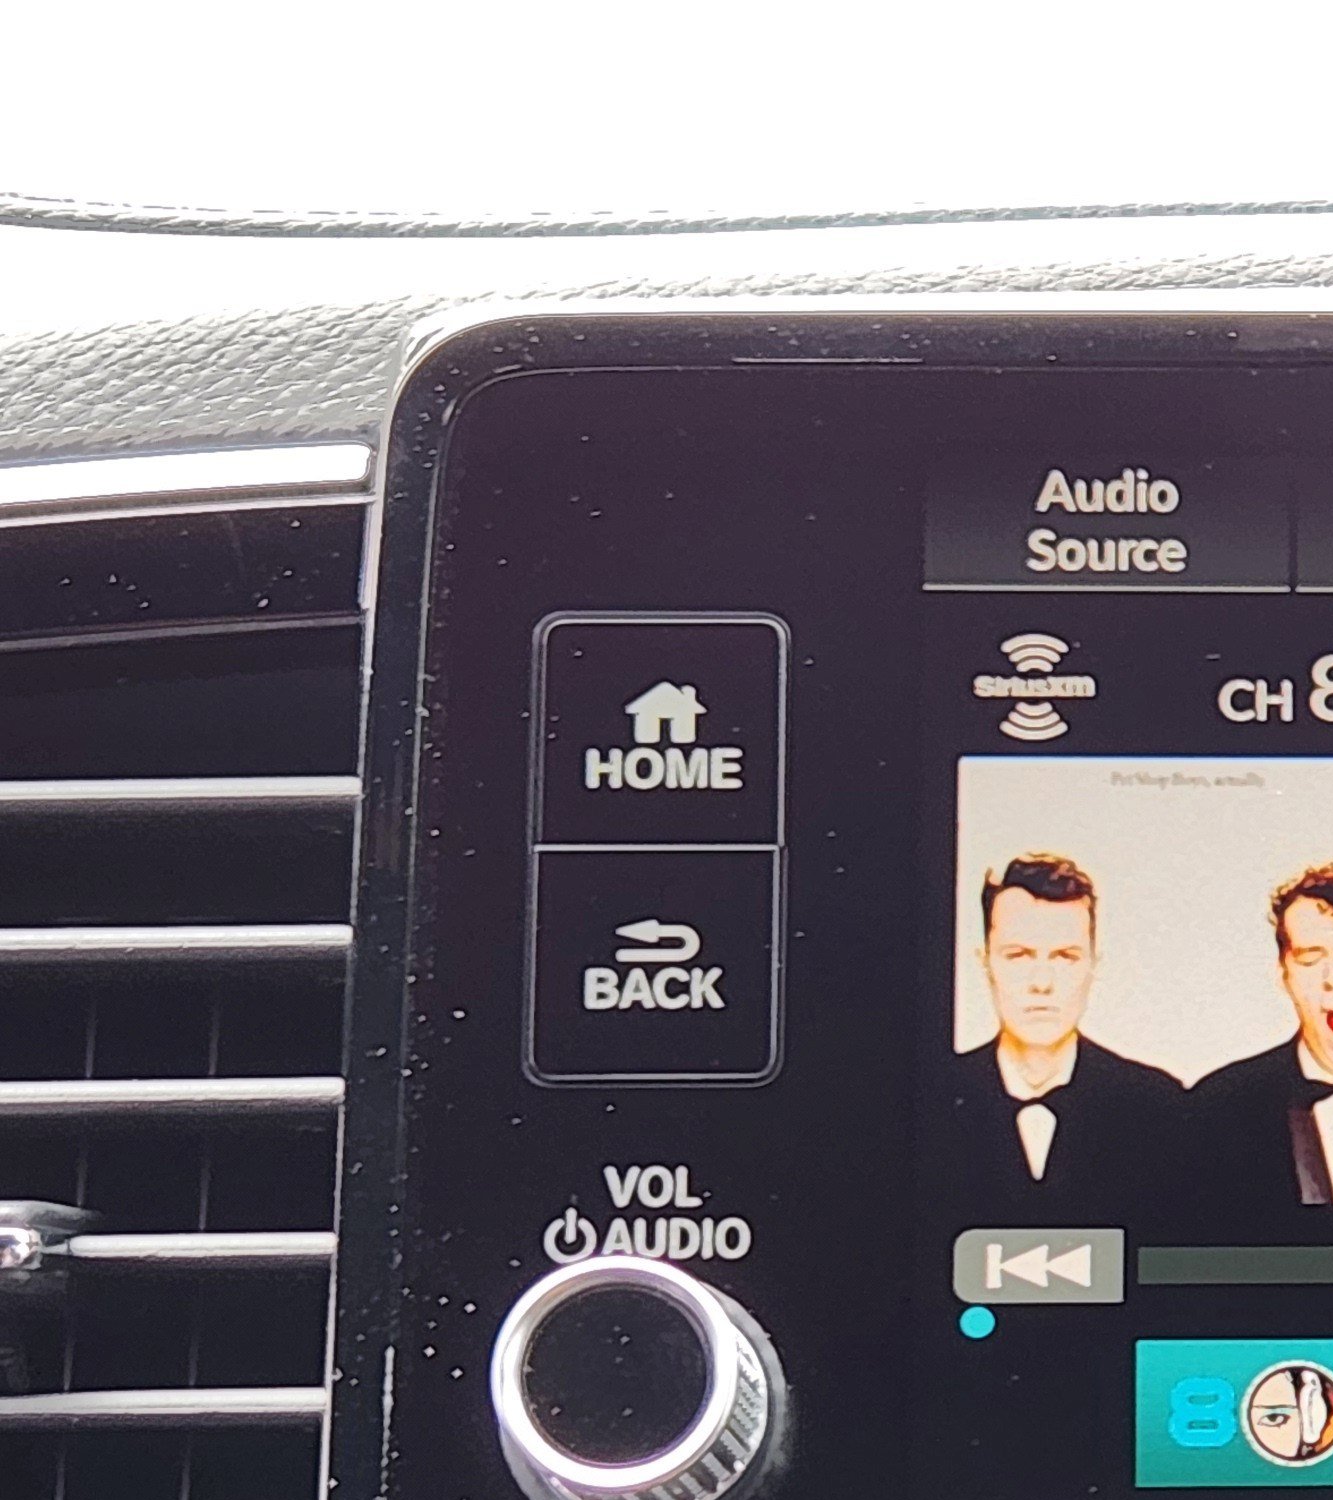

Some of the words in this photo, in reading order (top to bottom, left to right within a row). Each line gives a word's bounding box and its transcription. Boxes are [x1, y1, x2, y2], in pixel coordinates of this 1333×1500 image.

[1035, 468, 1179, 513] Audio
[1026, 528, 1187, 572] Source
[1218, 678, 1294, 722] CH
[585, 747, 743, 790] HOME
[583, 966, 725, 1010] BACK
[603, 1165, 703, 1208] VOL
[602, 1216, 752, 1260] AUDIO
